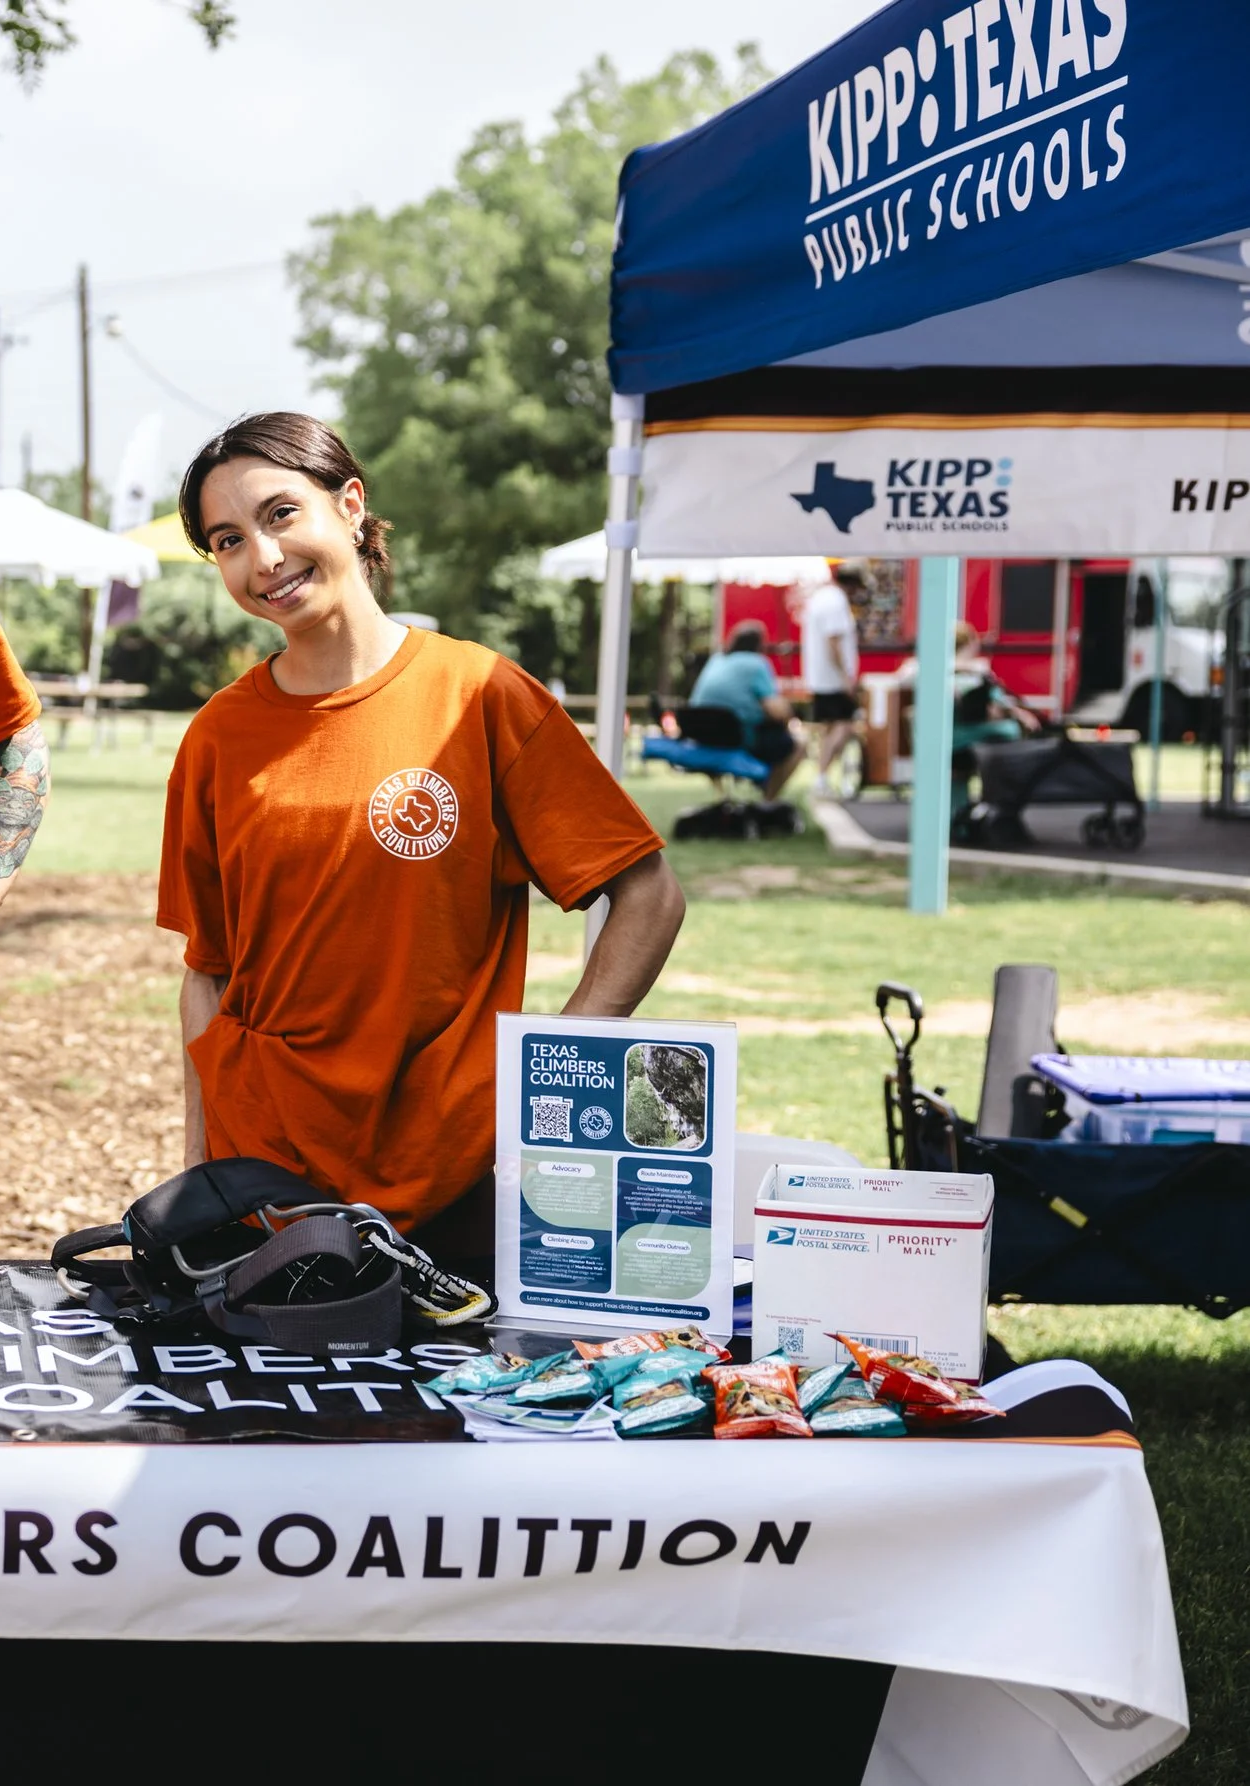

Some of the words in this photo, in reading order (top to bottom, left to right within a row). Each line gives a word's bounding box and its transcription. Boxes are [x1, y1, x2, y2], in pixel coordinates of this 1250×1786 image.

[803, 188, 913, 289] PUBLIC
[926, 104, 1127, 240] SCHOOLS
[886, 491, 1009, 518] TEXAS
[885, 521, 935, 531] PUBLIC
[942, 521, 1009, 531] SCHOOLS
[372, 776, 405, 816] TEXAS
[406, 772, 455, 823] CLIMBERS
[379, 826, 448, 855] COALITION
[530, 1043, 578, 1058] TEXAS
[530, 1058, 606, 1074] CLIMBERS
[530, 1072, 615, 1089] COALITION
[551, 1164, 582, 1174] Advocacy
[547, 1235, 569, 1243] Climbing
[799, 1227, 834, 1238] UNITED
[834, 1230, 865, 1240] STATES
[638, 1241, 666, 1249] Community
[667, 1243, 690, 1251] Outreach
[796, 1239, 830, 1250] POSTAL
[832, 1242, 867, 1252] SERVICE
[903, 1247, 936, 1256] MAIL
[640, 1305, 702, 1317] texasclimberscoalition.org
[327, 1341, 369, 1350] MOMENTUM
[178, 1511, 813, 1580] COALITTION
